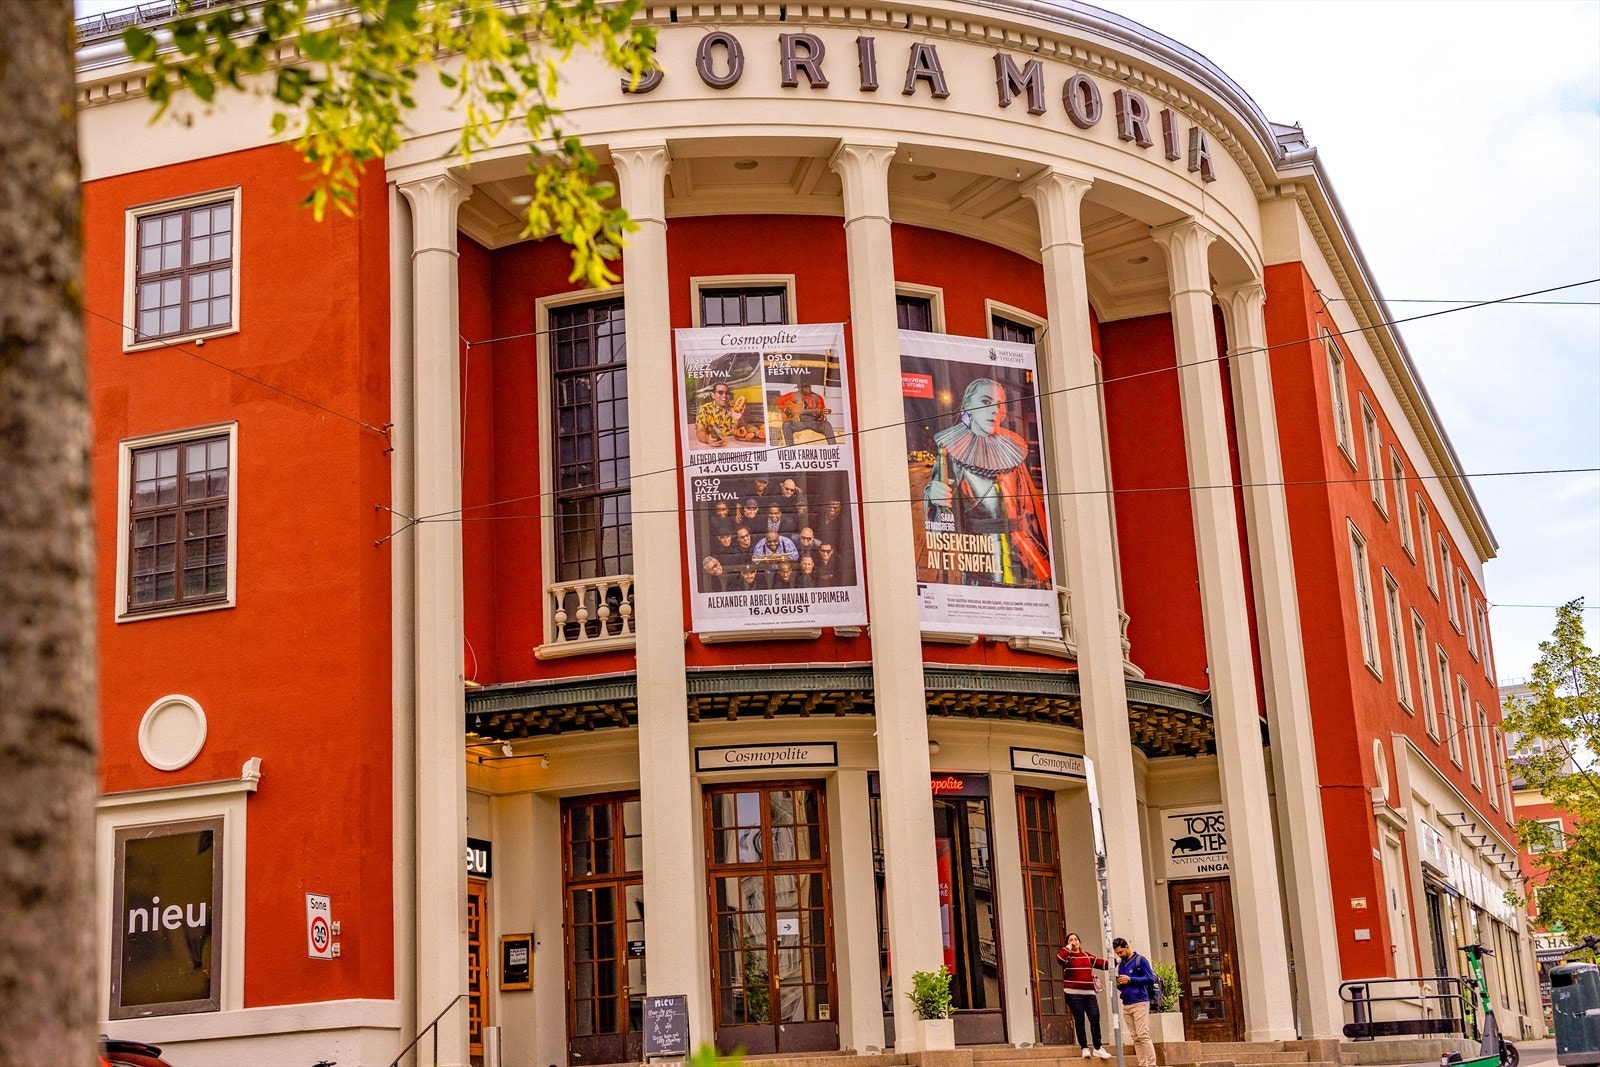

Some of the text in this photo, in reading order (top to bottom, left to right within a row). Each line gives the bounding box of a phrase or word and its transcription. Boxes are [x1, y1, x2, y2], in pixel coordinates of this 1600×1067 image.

[619, 31, 1217, 183] SORIA MORIA
[720, 330, 797, 349] Cosmopolite
[687, 356, 713, 365] OSLO
[767, 353, 793, 362] OSLO
[687, 363, 712, 372] JAZZ
[767, 361, 792, 369] JAZZ
[688, 370, 731, 379] FESTIVAL
[768, 367, 811, 376] FESTIVAL
[690, 453, 716, 466] ALFREDO
[753, 450, 768, 462] TRIO
[777, 446, 840, 461] VIEUX FARKA TOURÉ
[698, 463, 760, 474] 14.AUGUST
[779, 460, 839, 470] 15.AUGUST
[694, 478, 720, 487] OSLO
[695, 486, 720, 494] JAZZ
[695, 492, 739, 502] FESTIVAL
[940, 512, 955, 522] SARA
[925, 531, 994, 554] DISSEKERING
[927, 551, 1003, 573] AV ET SNØFALL
[708, 595, 748, 608] ALEXANDER
[750, 594, 773, 607] ABREU
[774, 593, 780, 605] &
[781, 592, 809, 605] HAVANA
[748, 605, 810, 616] 16.AUGUST
[724, 747, 808, 764] Cosmopolite
[1031, 753, 1080, 772] Cosmopolite
[1184, 814, 1226, 835] TORS
[466, 847, 487, 873] eu
[1197, 863, 1230, 873] INNGA
[310, 897, 327, 911] Sone
[127, 896, 207, 934] nieu
[314, 925, 326, 944] 30
